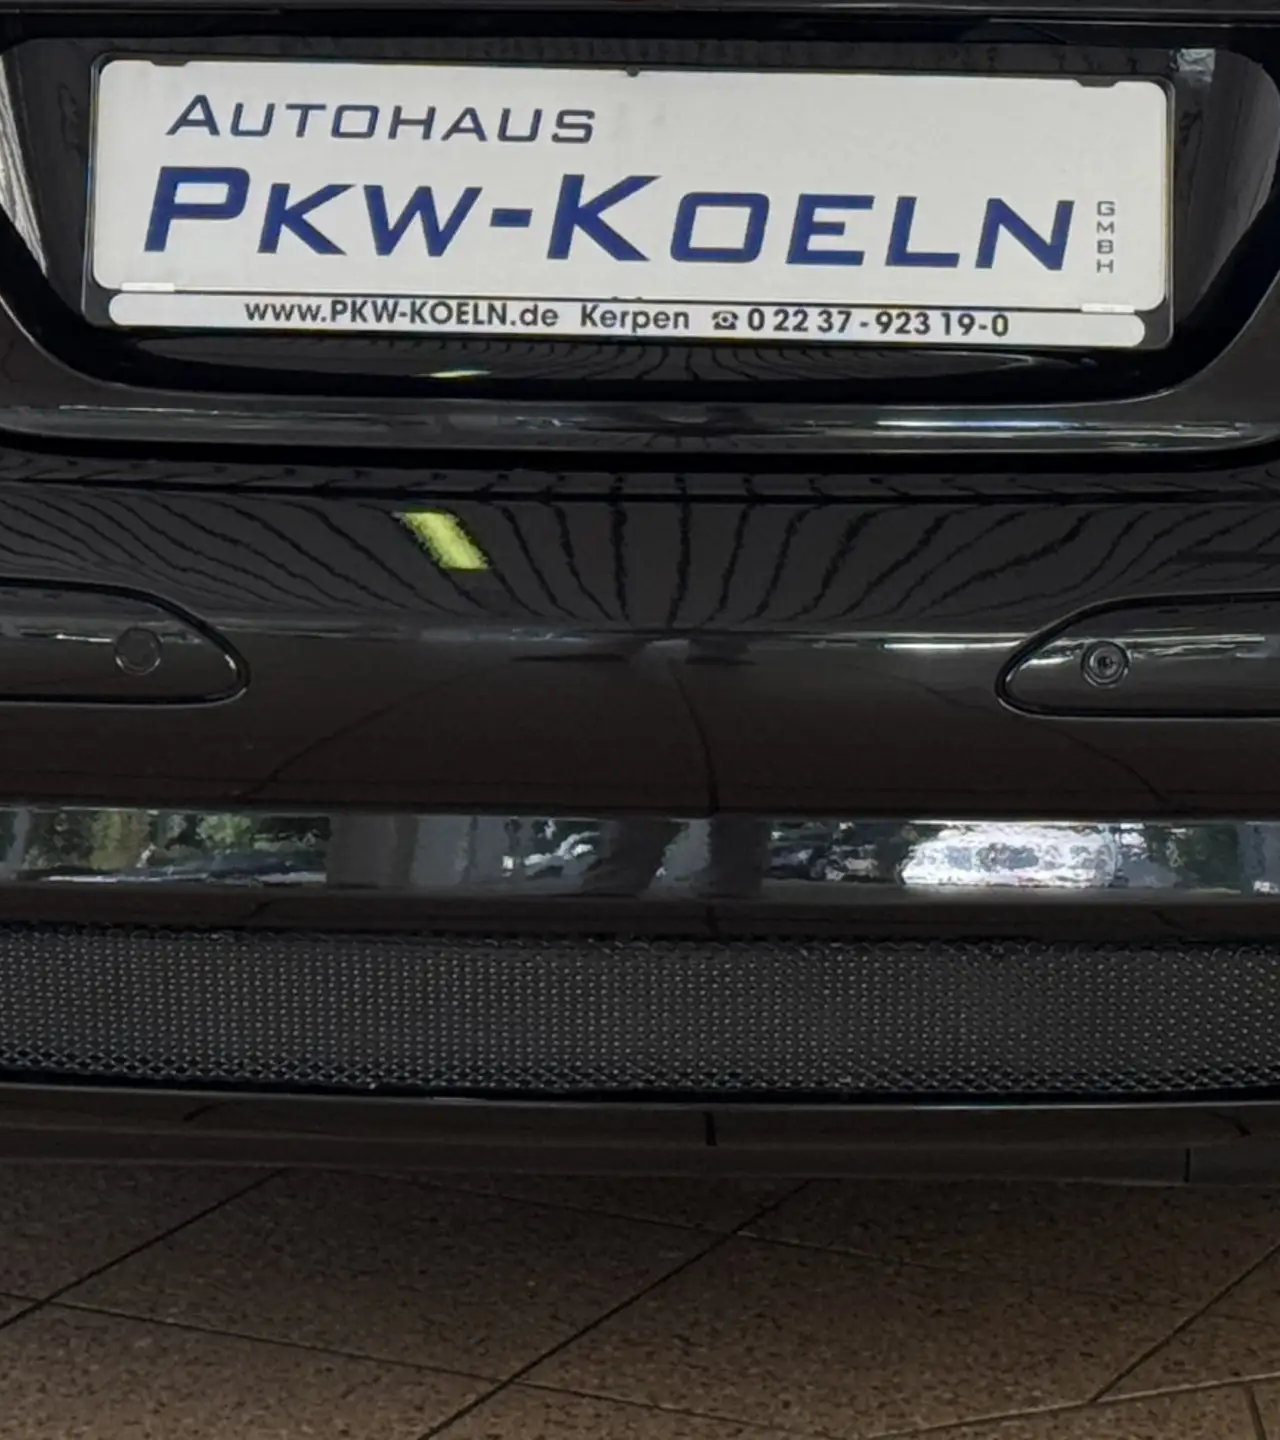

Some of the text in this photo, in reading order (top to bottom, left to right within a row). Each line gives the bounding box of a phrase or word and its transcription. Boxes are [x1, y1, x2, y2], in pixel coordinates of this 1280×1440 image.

[165, 94, 597, 144] AUTOHAUS
[144, 165, 1076, 271] PKW-KOELN
[244, 298, 560, 328] www.PKW-KOELN.de
[579, 303, 690, 335] Kerpen
